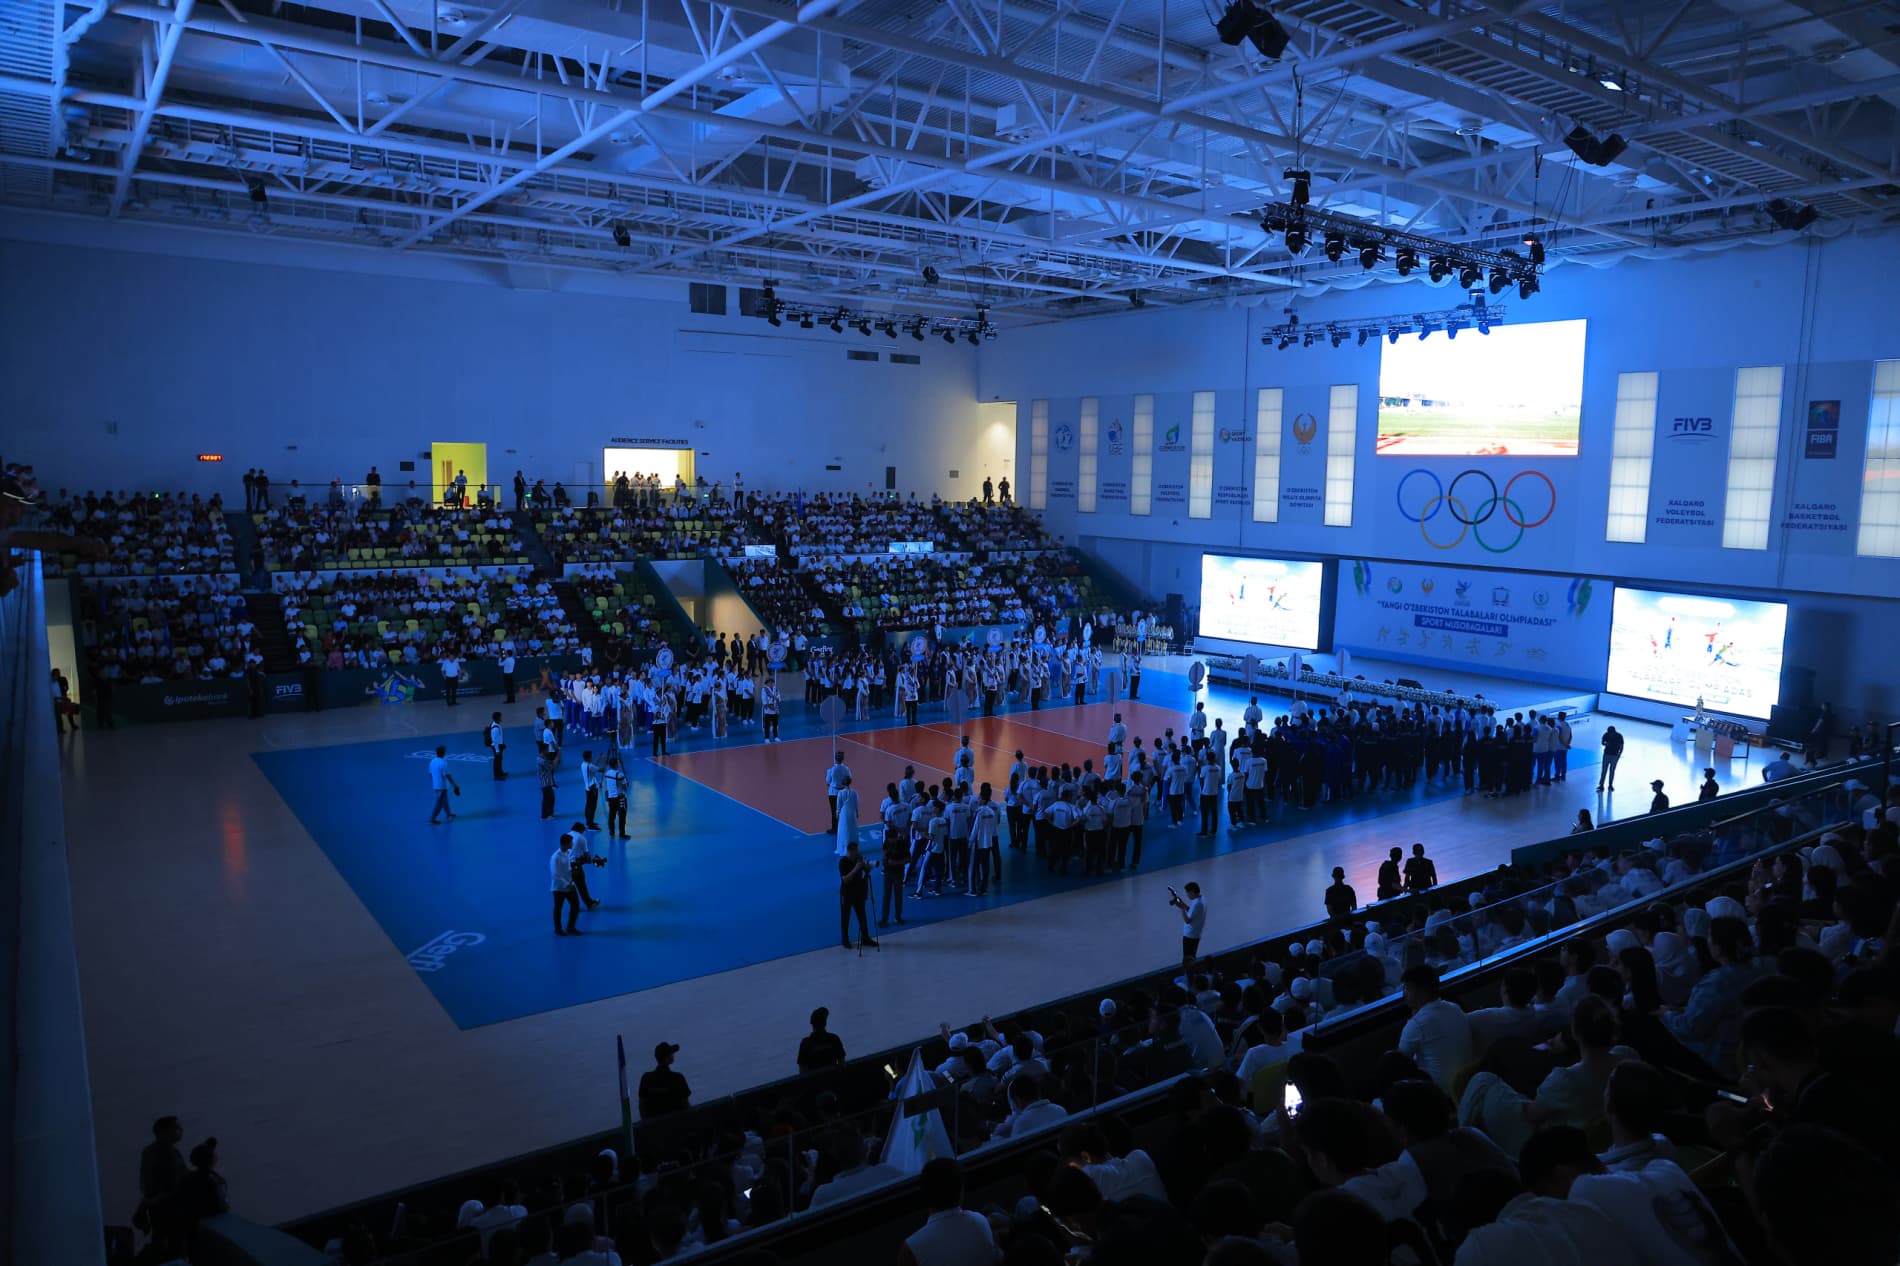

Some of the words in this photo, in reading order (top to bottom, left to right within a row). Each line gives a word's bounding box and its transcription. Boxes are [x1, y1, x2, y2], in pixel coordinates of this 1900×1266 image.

[1673, 417, 1712, 432] FIVB
[1810, 433, 1833, 444] FIBA
[1665, 508, 1706, 517] VOLEYBOL
[1788, 512, 1841, 521] BASKETBOL
[1655, 517, 1714, 527] FEDERATSIYASI
[1780, 522, 1848, 531] FEDERATSIYASI
[1451, 607, 1498, 621] TALABALARI
[1421, 617, 1444, 627] SPORT
[1444, 620, 1503, 634] MUSOBAQALARI
[275, 683, 302, 694] FIVB
